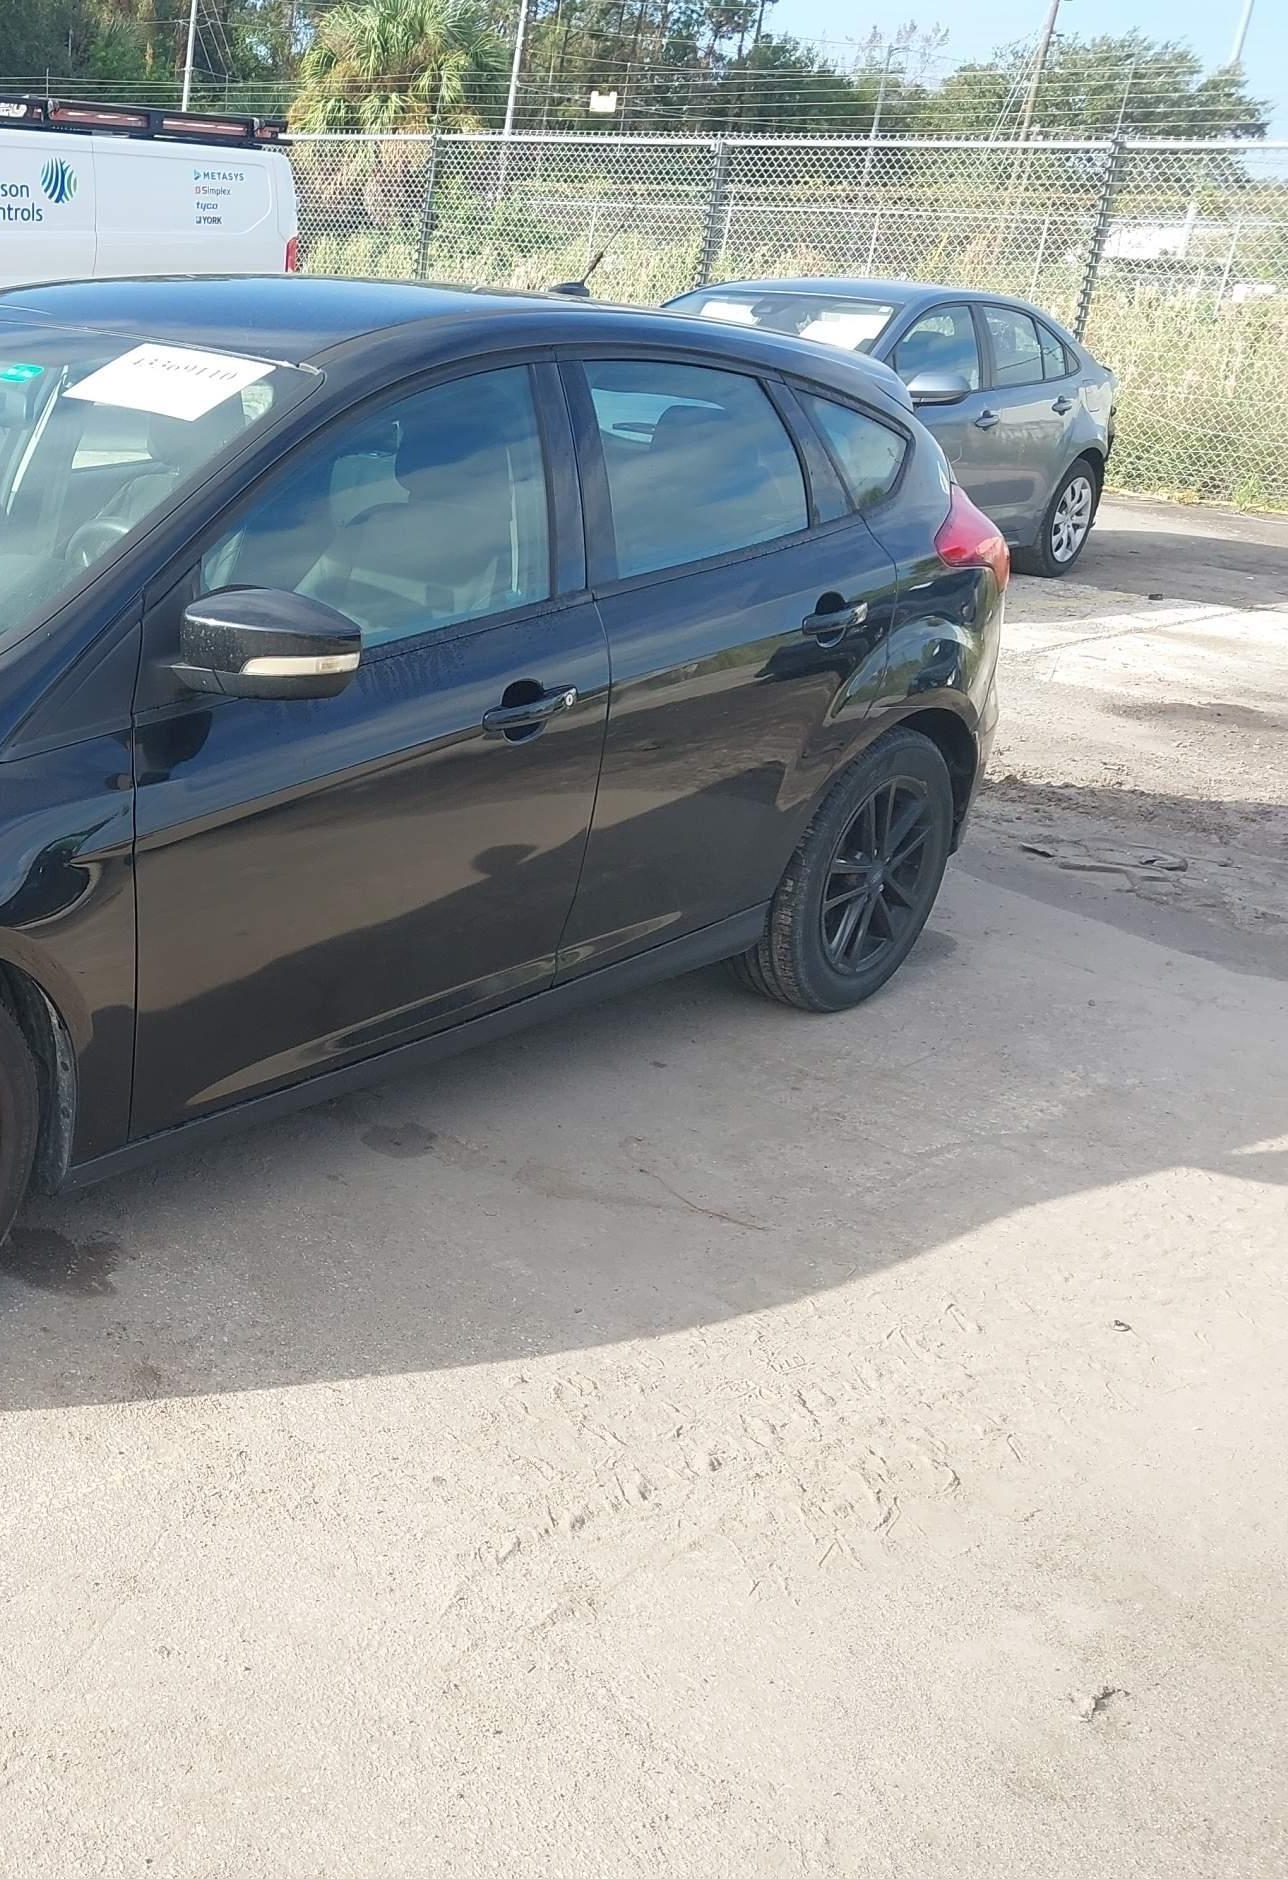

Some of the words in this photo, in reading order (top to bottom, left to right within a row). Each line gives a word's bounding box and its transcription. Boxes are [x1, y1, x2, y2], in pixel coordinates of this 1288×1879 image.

[203, 171, 244, 181] METASYS
[201, 186, 231, 196] Simplex
[196, 201, 218, 211] tyco
[202, 216, 222, 224] YORK
